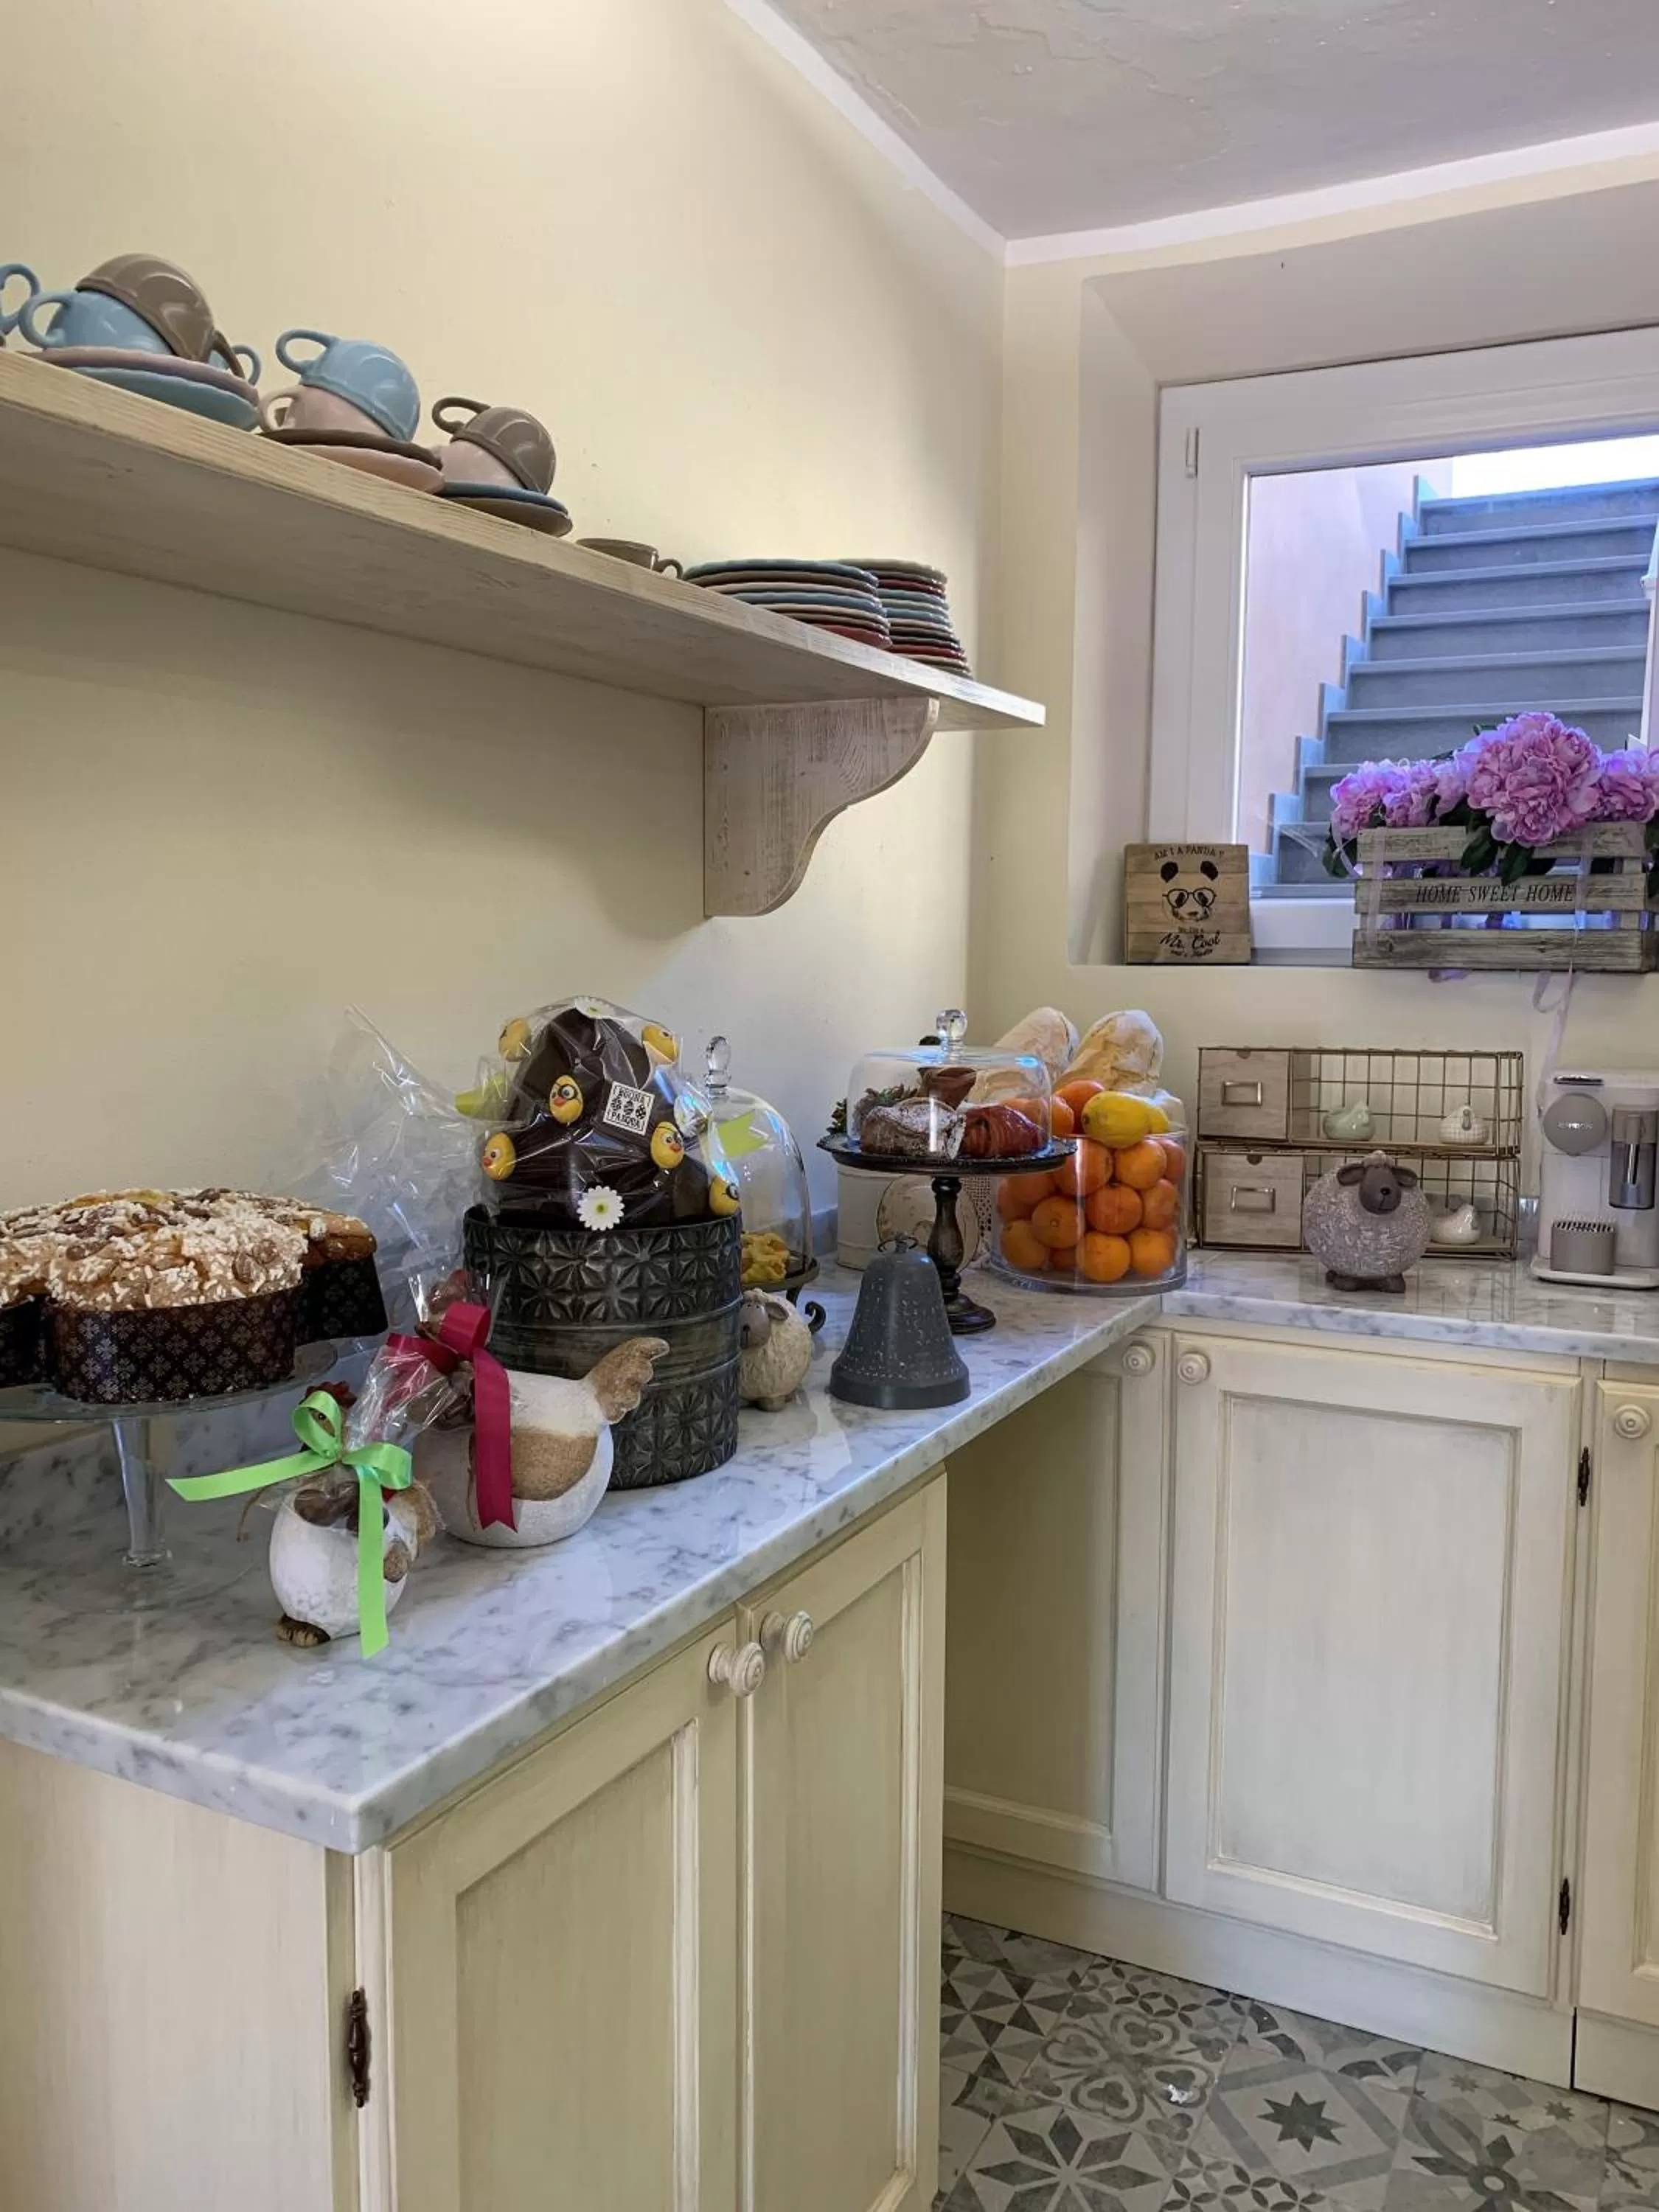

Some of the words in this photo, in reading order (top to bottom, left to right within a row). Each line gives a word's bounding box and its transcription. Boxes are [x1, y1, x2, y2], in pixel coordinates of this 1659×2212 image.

[1415, 885, 1462, 903] HOME
[1468, 884, 1518, 903] SWEET
[1526, 884, 1576, 902] HOME
[1192, 929, 1221, 950] Cool
